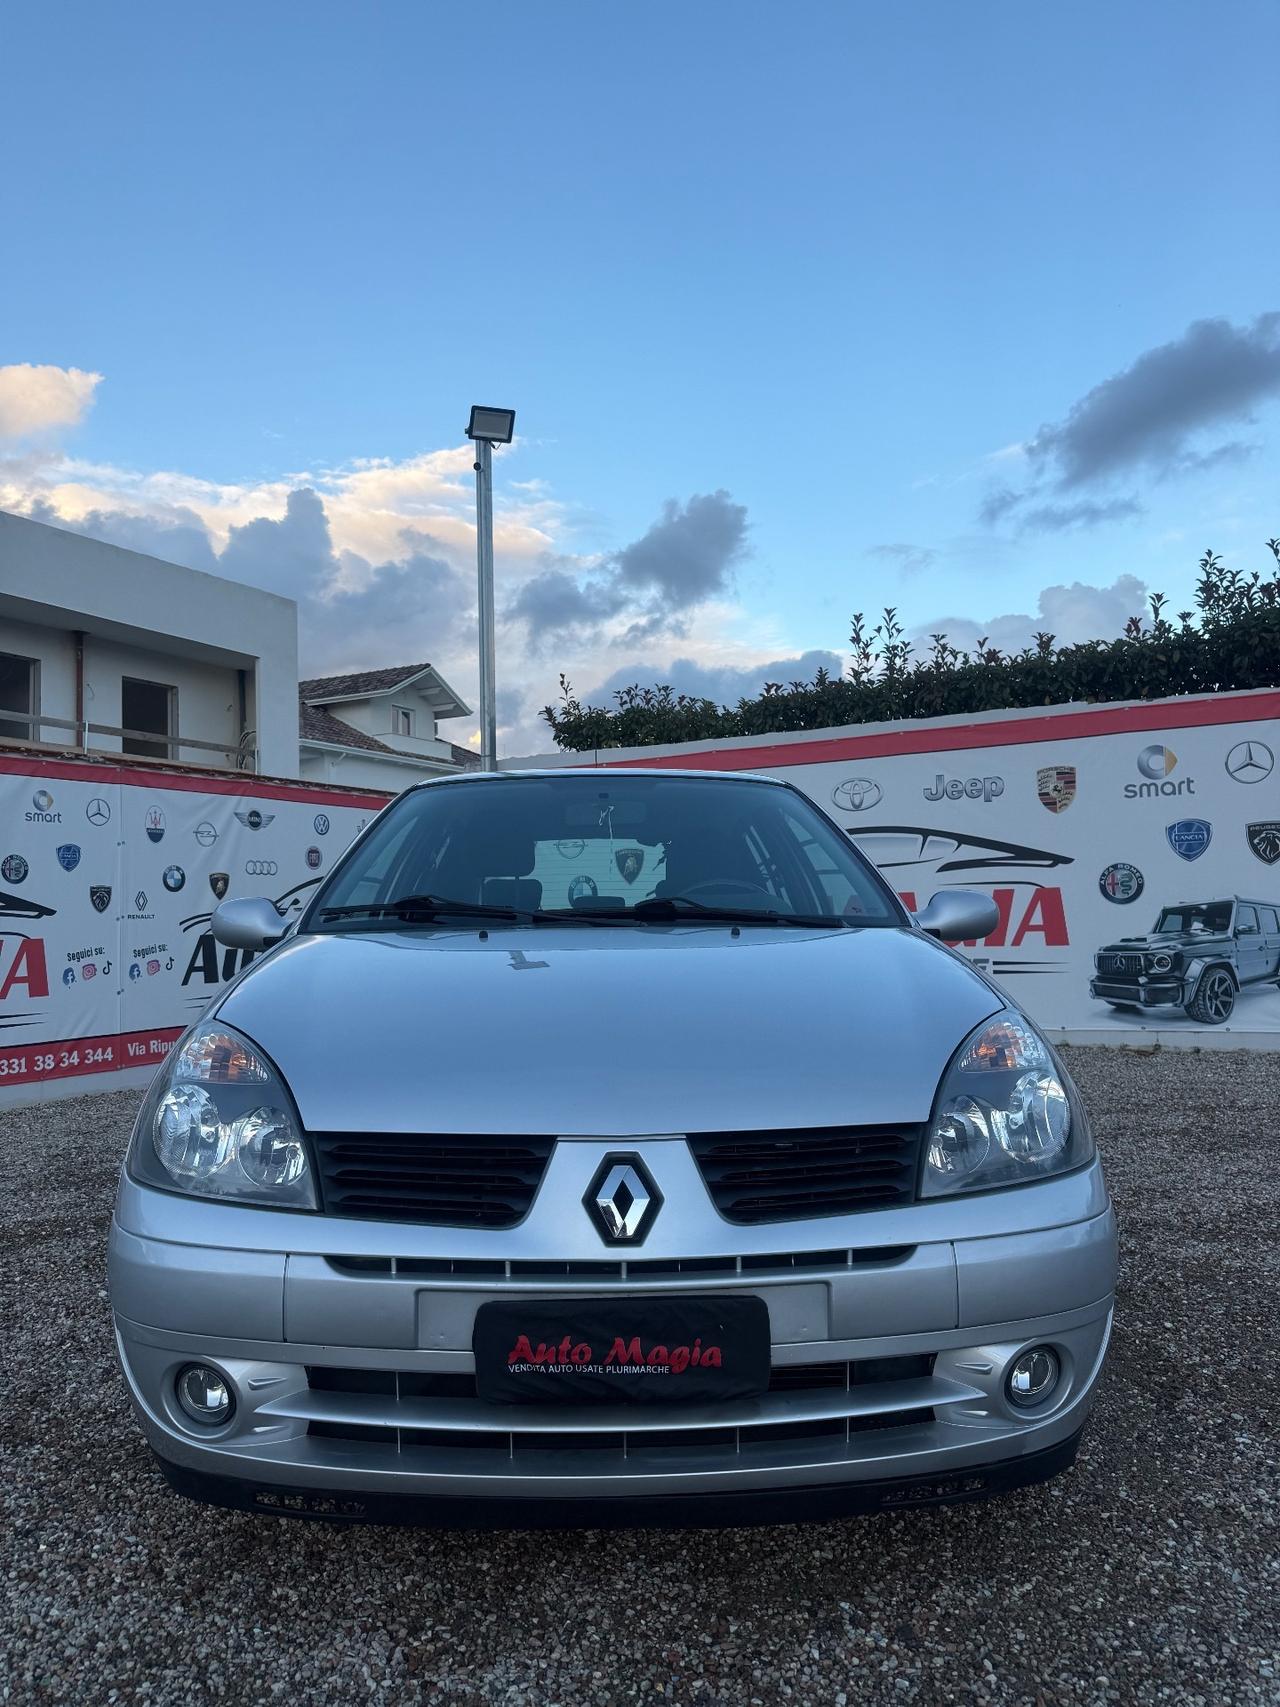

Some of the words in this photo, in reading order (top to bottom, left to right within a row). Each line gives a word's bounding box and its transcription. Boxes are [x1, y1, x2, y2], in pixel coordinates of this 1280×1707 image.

[923, 774, 1005, 802] Jeep
[1124, 777, 1195, 799] smart
[25, 811, 62, 824] smart
[1175, 834, 1204, 842] LANCIA
[1100, 866, 1115, 885] ALFA
[1117, 863, 1143, 884] ROMEO
[67, 947, 93, 962] Seguici
[94, 946, 105, 956] su:
[133, 944, 157, 958] Seguici
[158, 943, 168, 952] su:
[128, 1042, 146, 1056] Via
[0, 1057, 27, 1076] 331
[34, 1054, 55, 1071] 38
[60, 1050, 80, 1067] 34
[85, 1047, 114, 1064] 344
[508, 1335, 592, 1365] Auto
[604, 1337, 722, 1374] Magia
[508, 1363, 546, 1373] VENDITA
[549, 1364, 573, 1373] AUTO
[575, 1364, 604, 1373] USATE
[606, 1365, 670, 1374] PLURIMARCHE
